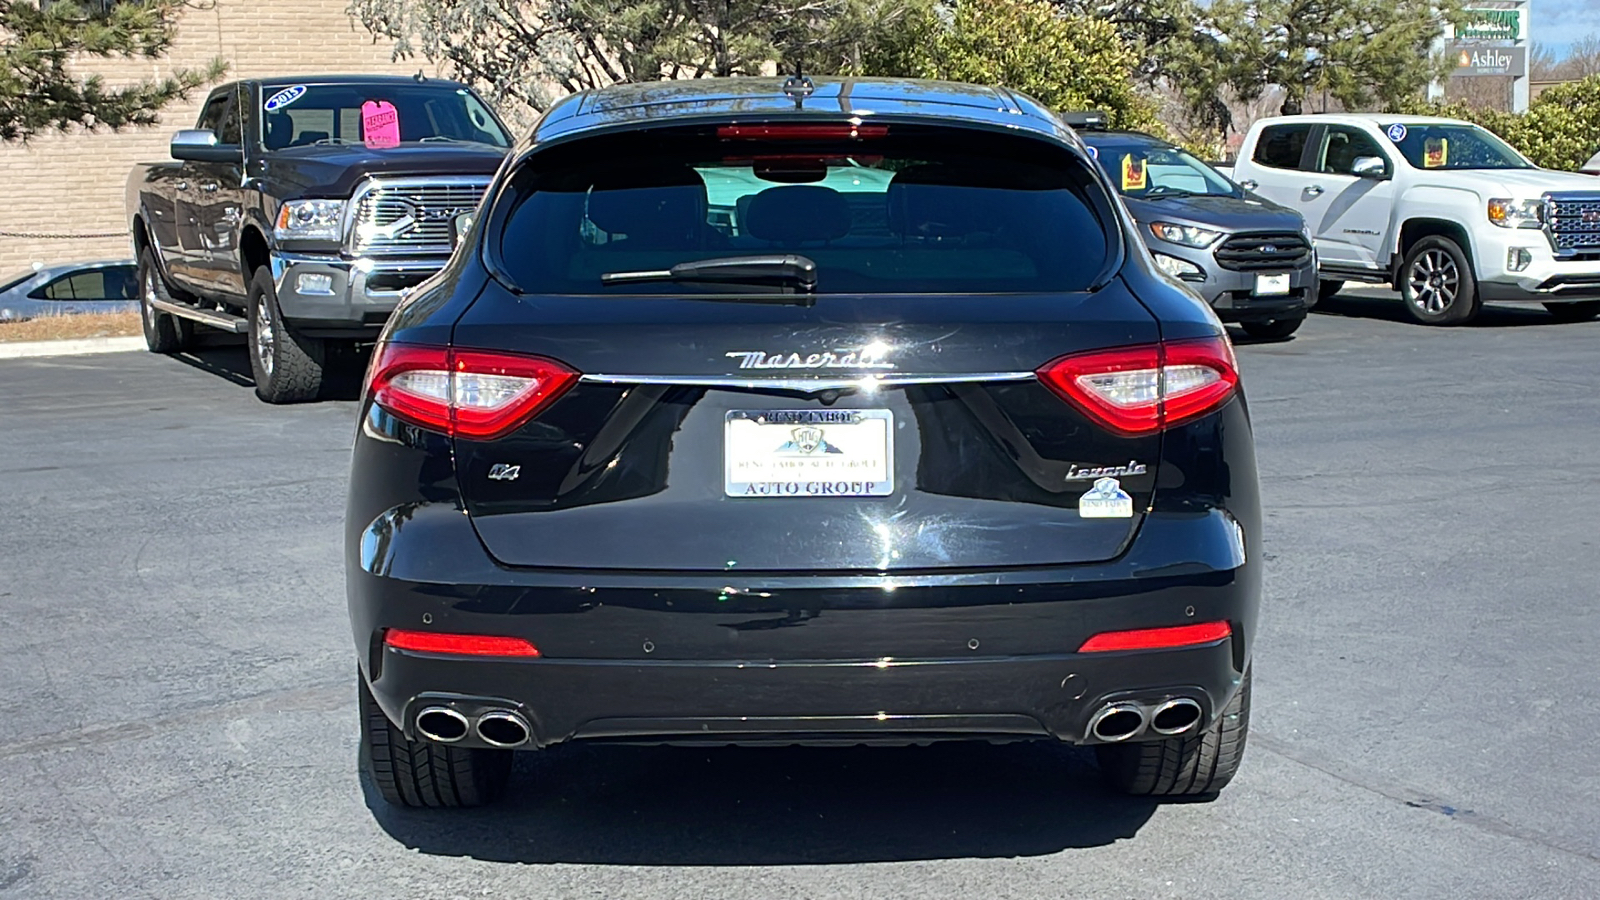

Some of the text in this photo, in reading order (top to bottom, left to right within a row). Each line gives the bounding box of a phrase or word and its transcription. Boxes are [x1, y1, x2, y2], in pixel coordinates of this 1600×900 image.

[1470, 49, 1512, 71] Ashley
[272, 86, 299, 106] 2015
[725, 351, 895, 369] Maserat
[765, 410, 803, 422] RENO
[1065, 460, 1147, 480] Levante
[745, 481, 875, 494] AUTO GROUP
